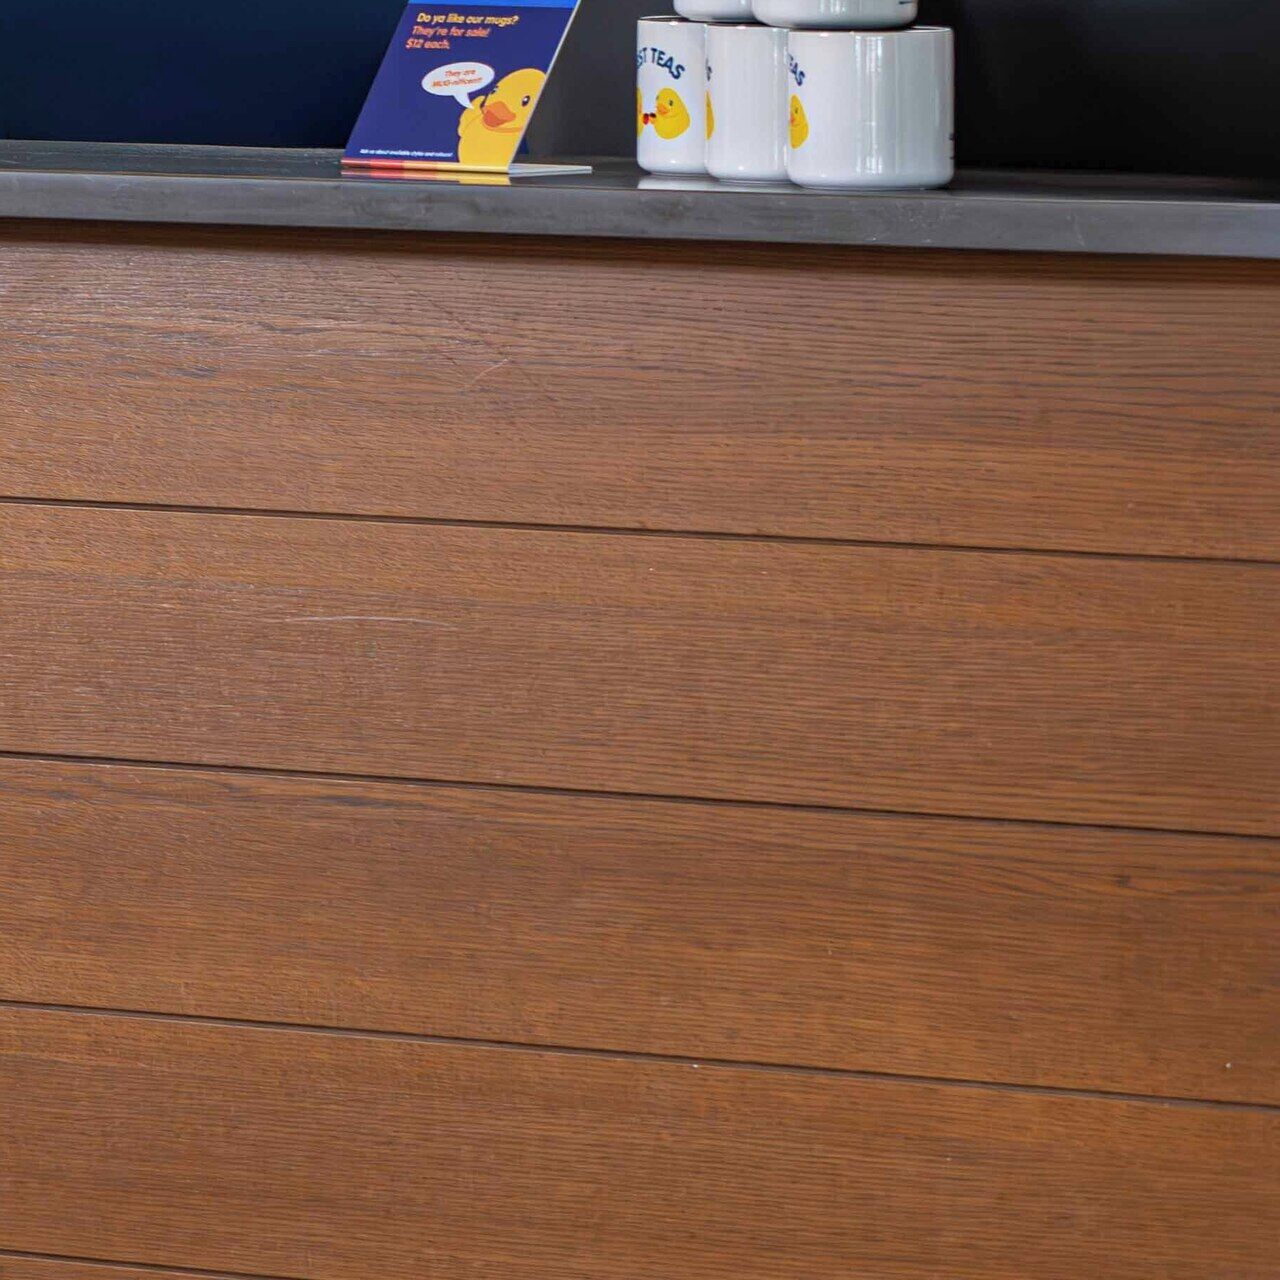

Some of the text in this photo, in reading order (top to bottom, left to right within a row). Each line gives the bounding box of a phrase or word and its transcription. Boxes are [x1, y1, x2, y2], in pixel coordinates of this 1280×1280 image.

[412, 25, 448, 38] They're
[449, 26, 466, 37] for
[417, 12, 519, 28] Do ya like our mugs?
[650, 47, 686, 81] TEAS
[789, 52, 806, 87] EAS
